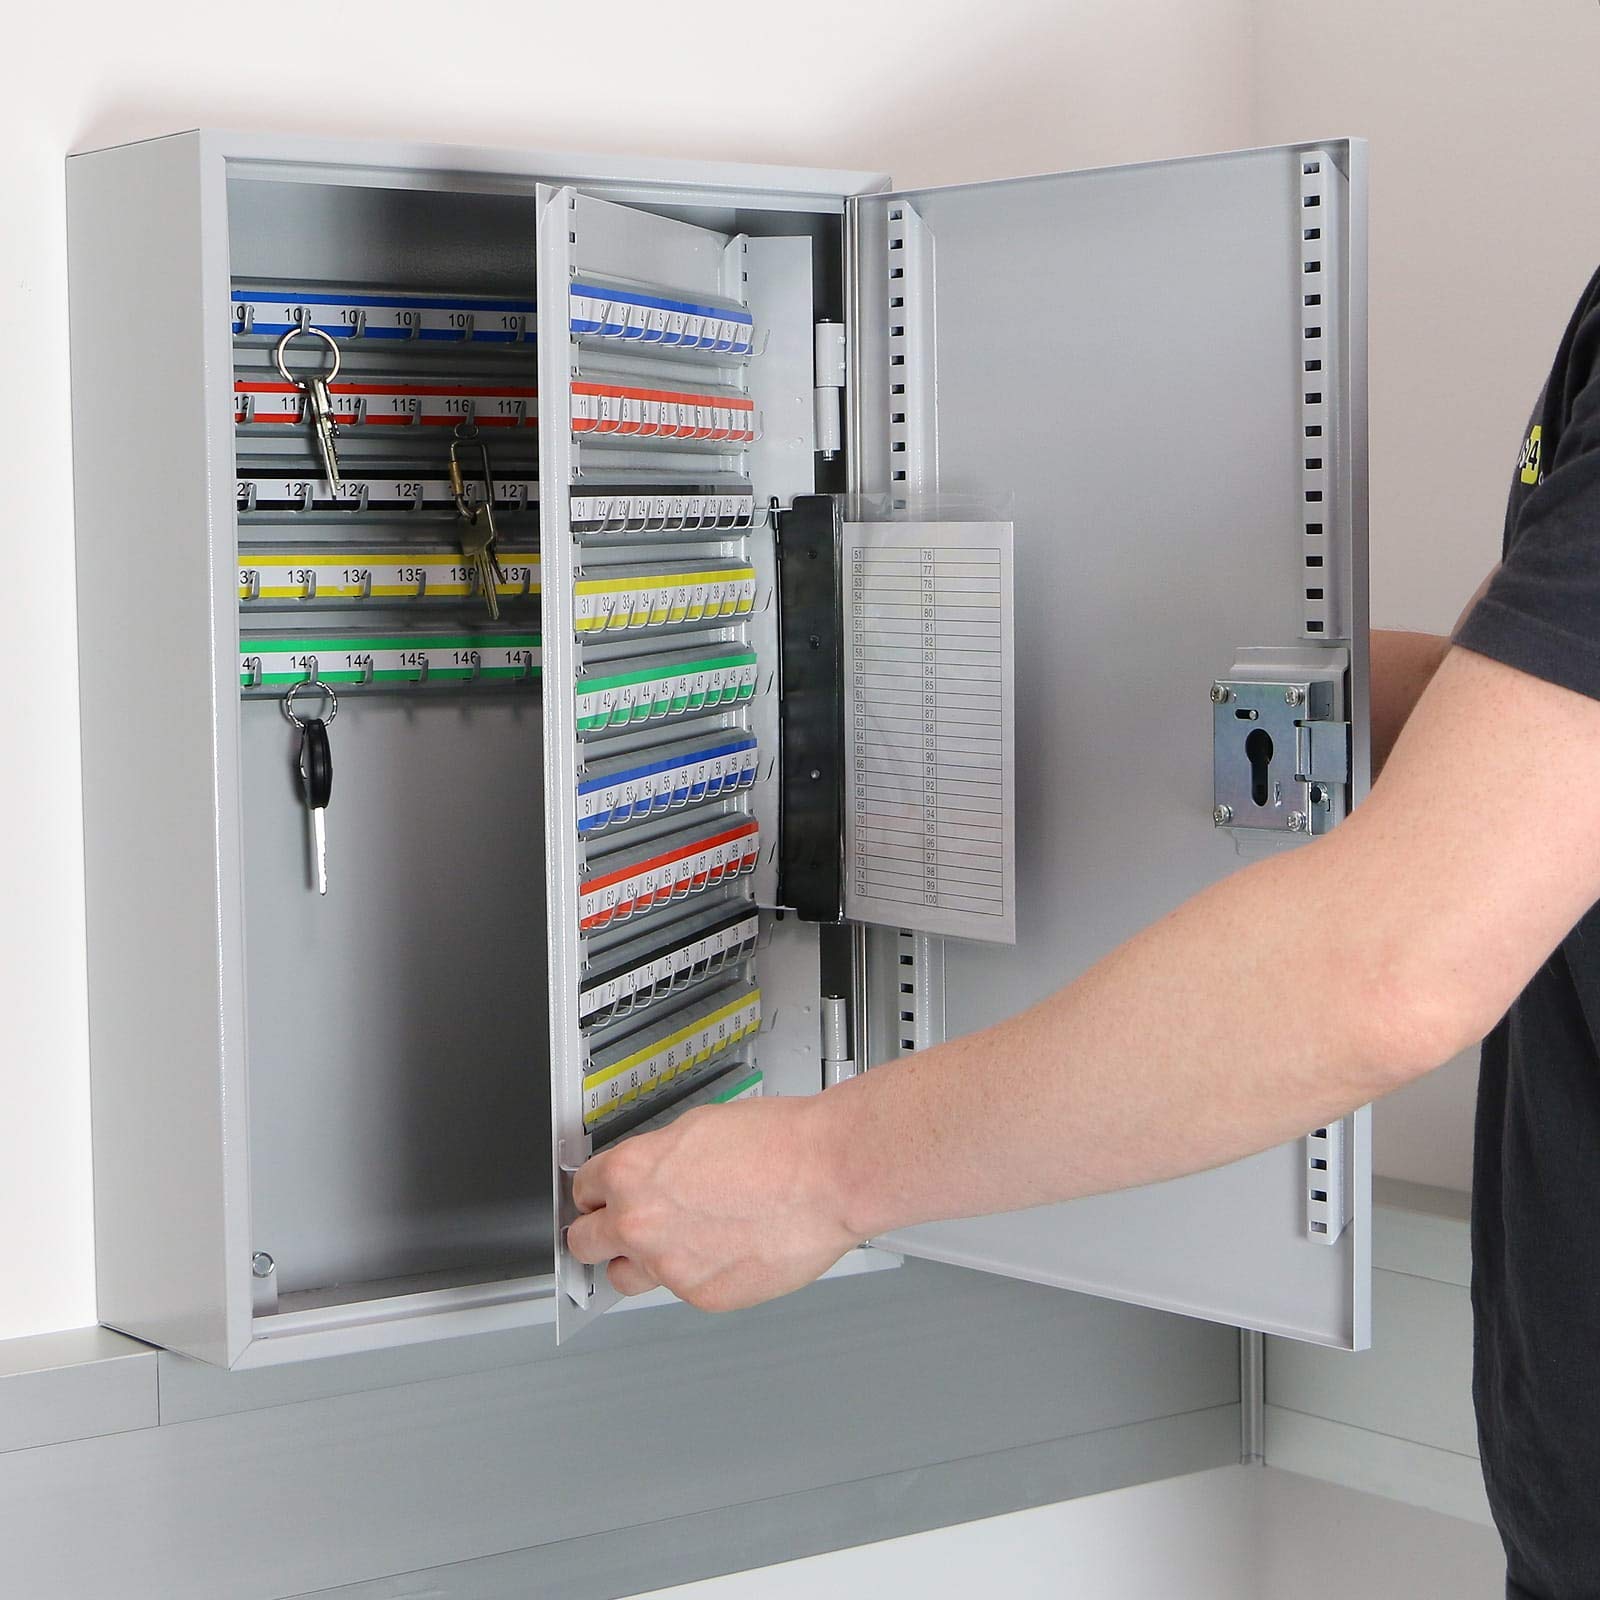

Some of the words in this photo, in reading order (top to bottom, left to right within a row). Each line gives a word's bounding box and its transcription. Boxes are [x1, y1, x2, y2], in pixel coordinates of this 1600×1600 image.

[392, 398, 417, 412] 115
[445, 399, 470, 413] 116
[498, 400, 522, 414] 117
[503, 567, 528, 581] 137
[582, 598, 589, 614] 31
[602, 596, 610, 612] 32
[623, 594, 630, 610] 33
[642, 592, 649, 608] 34
[400, 652, 426, 666] 145
[583, 697, 590, 712] 41
[603, 692, 611, 708] 42
[623, 688, 631, 704] 43
[643, 684, 650, 700] 44
[585, 799, 592, 815] 51
[606, 792, 613, 808] 52
[626, 786, 633, 802] 53
[645, 780, 652, 796] 54
[587, 898, 594, 914] 61
[607, 890, 614, 907] 62
[627, 882, 634, 899] 63
[646, 875, 653, 891] 64
[588, 992, 595, 1008] 71
[608, 982, 615, 999] 72
[628, 973, 635, 990] 73
[647, 965, 653, 980] 74
[592, 1092, 599, 1108] 81
[611, 1081, 618, 1098] 82
[631, 1071, 638, 1088] 83
[650, 1061, 657, 1077] 84
